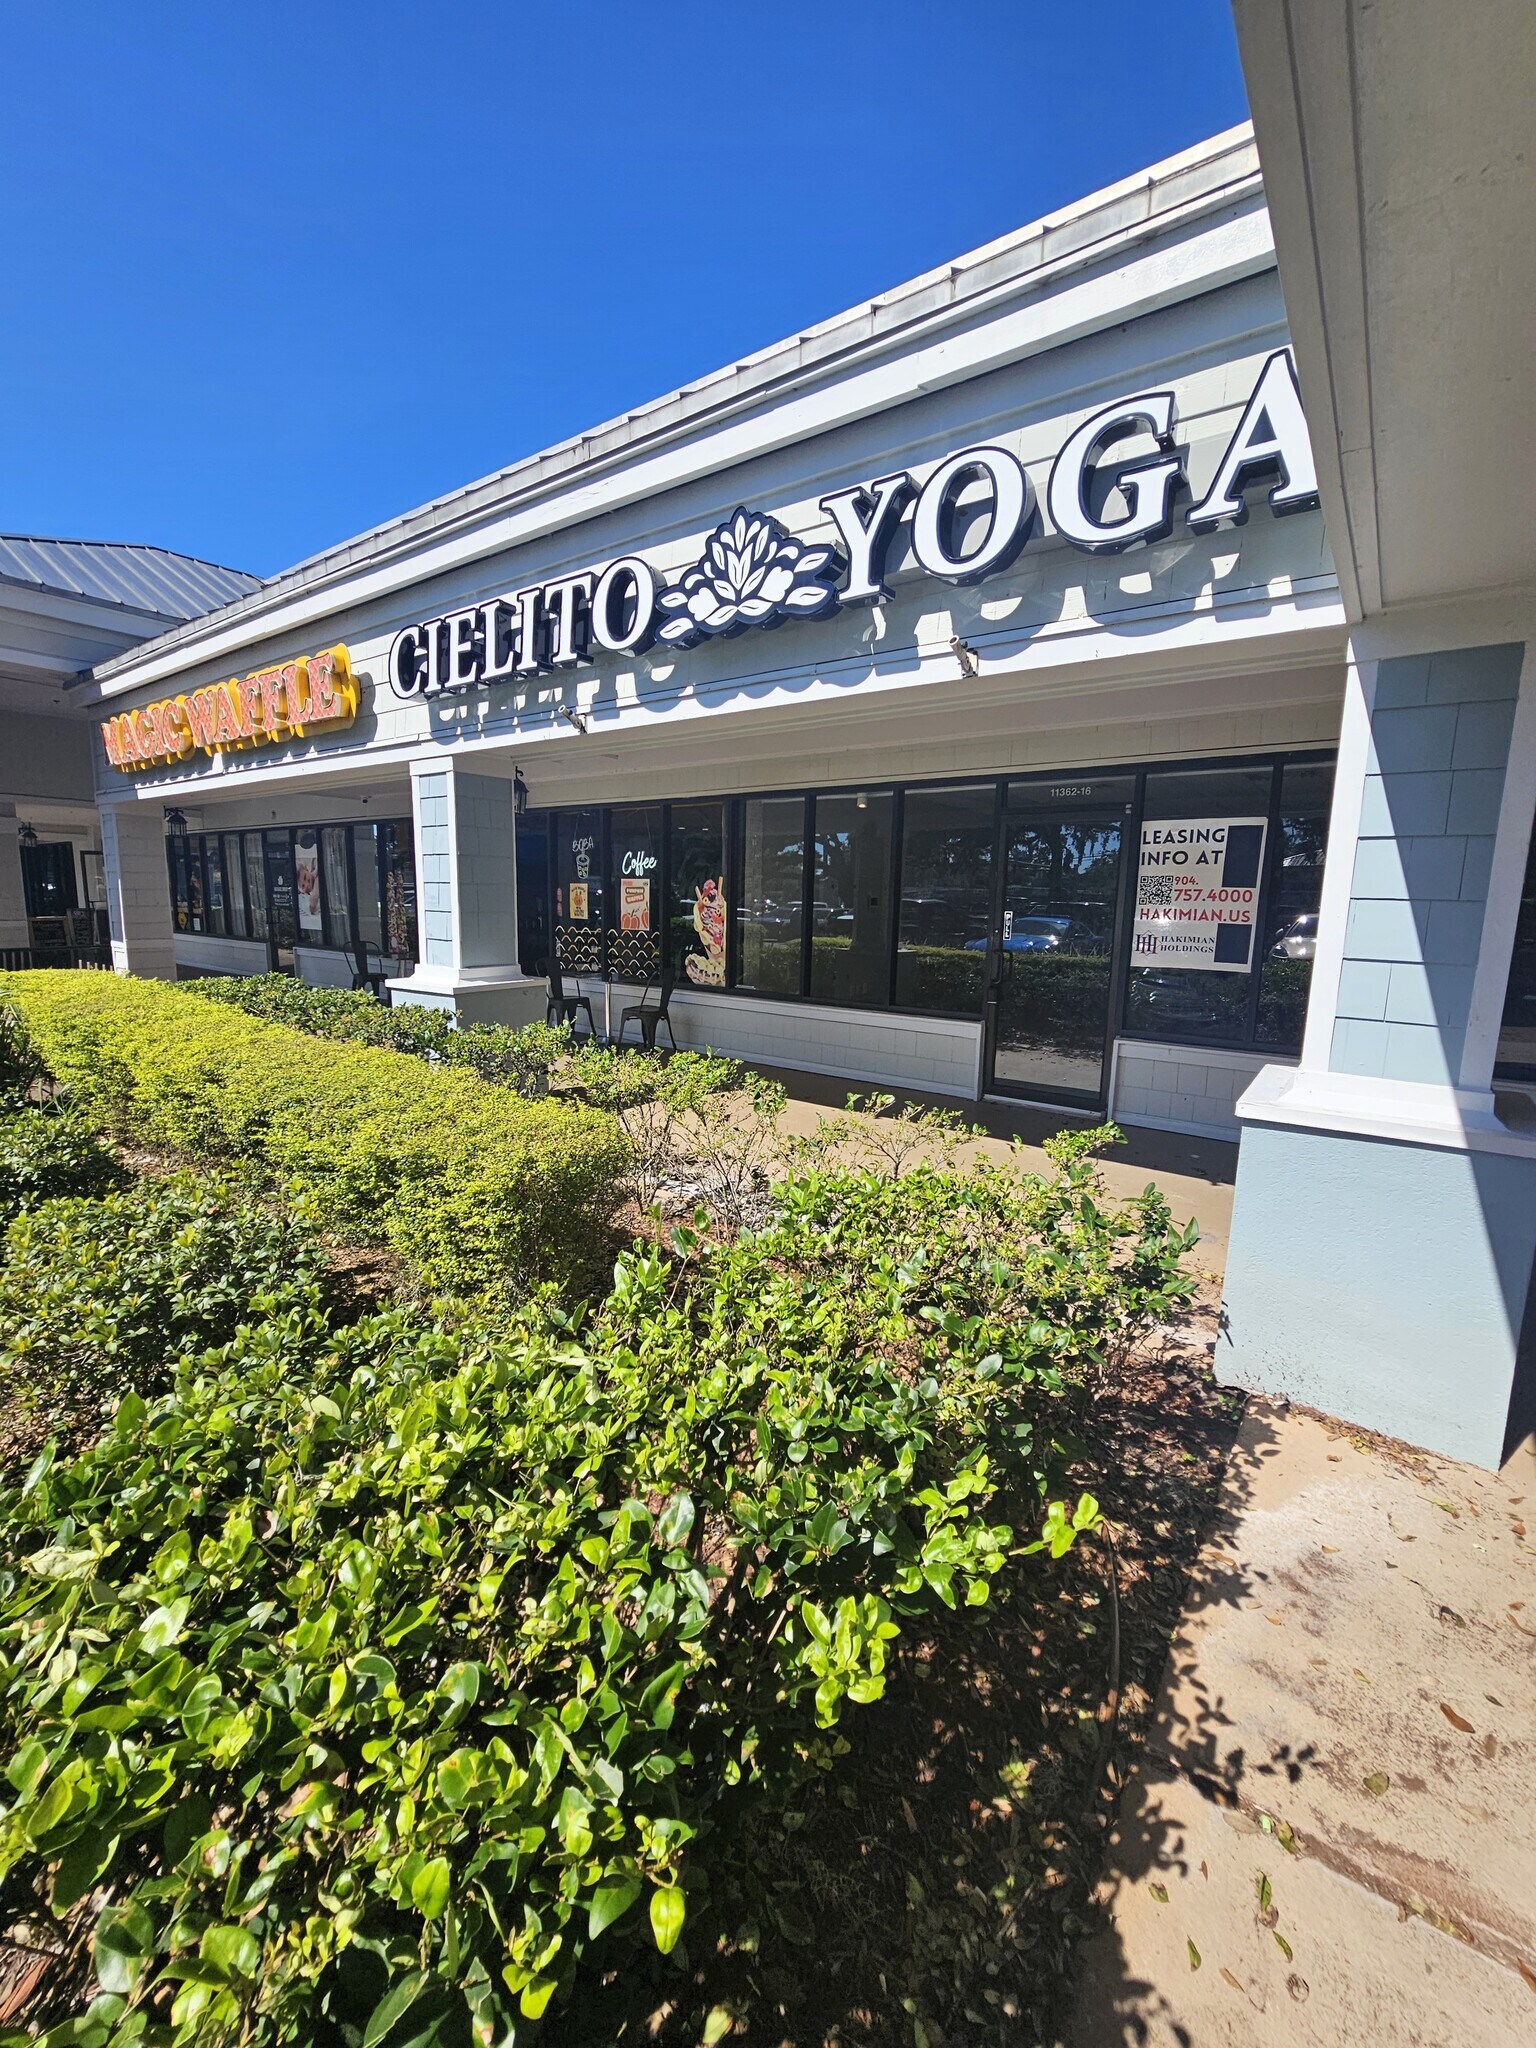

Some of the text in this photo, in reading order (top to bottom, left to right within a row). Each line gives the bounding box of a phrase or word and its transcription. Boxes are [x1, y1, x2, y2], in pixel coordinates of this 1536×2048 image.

[389, 347, 1320, 700] CIELITO YOGA
[101, 651, 344, 766] MAGIC WAFFLE
[1050, 786, 1091, 798] 11362-16
[572, 836, 594, 852] BOBA
[1142, 828, 1225, 845] LEASING
[622, 851, 657, 876] Coffee
[1140, 850, 1223, 866] INFO AT
[1174, 876, 1199, 886] 904.
[1173, 888, 1253, 903] 757.4000
[1140, 908, 1251, 923] HAKIMIAN.US
[1161, 935, 1216, 944] HAKIMIAN
[1160, 944, 1214, 953] HOLDINGS
